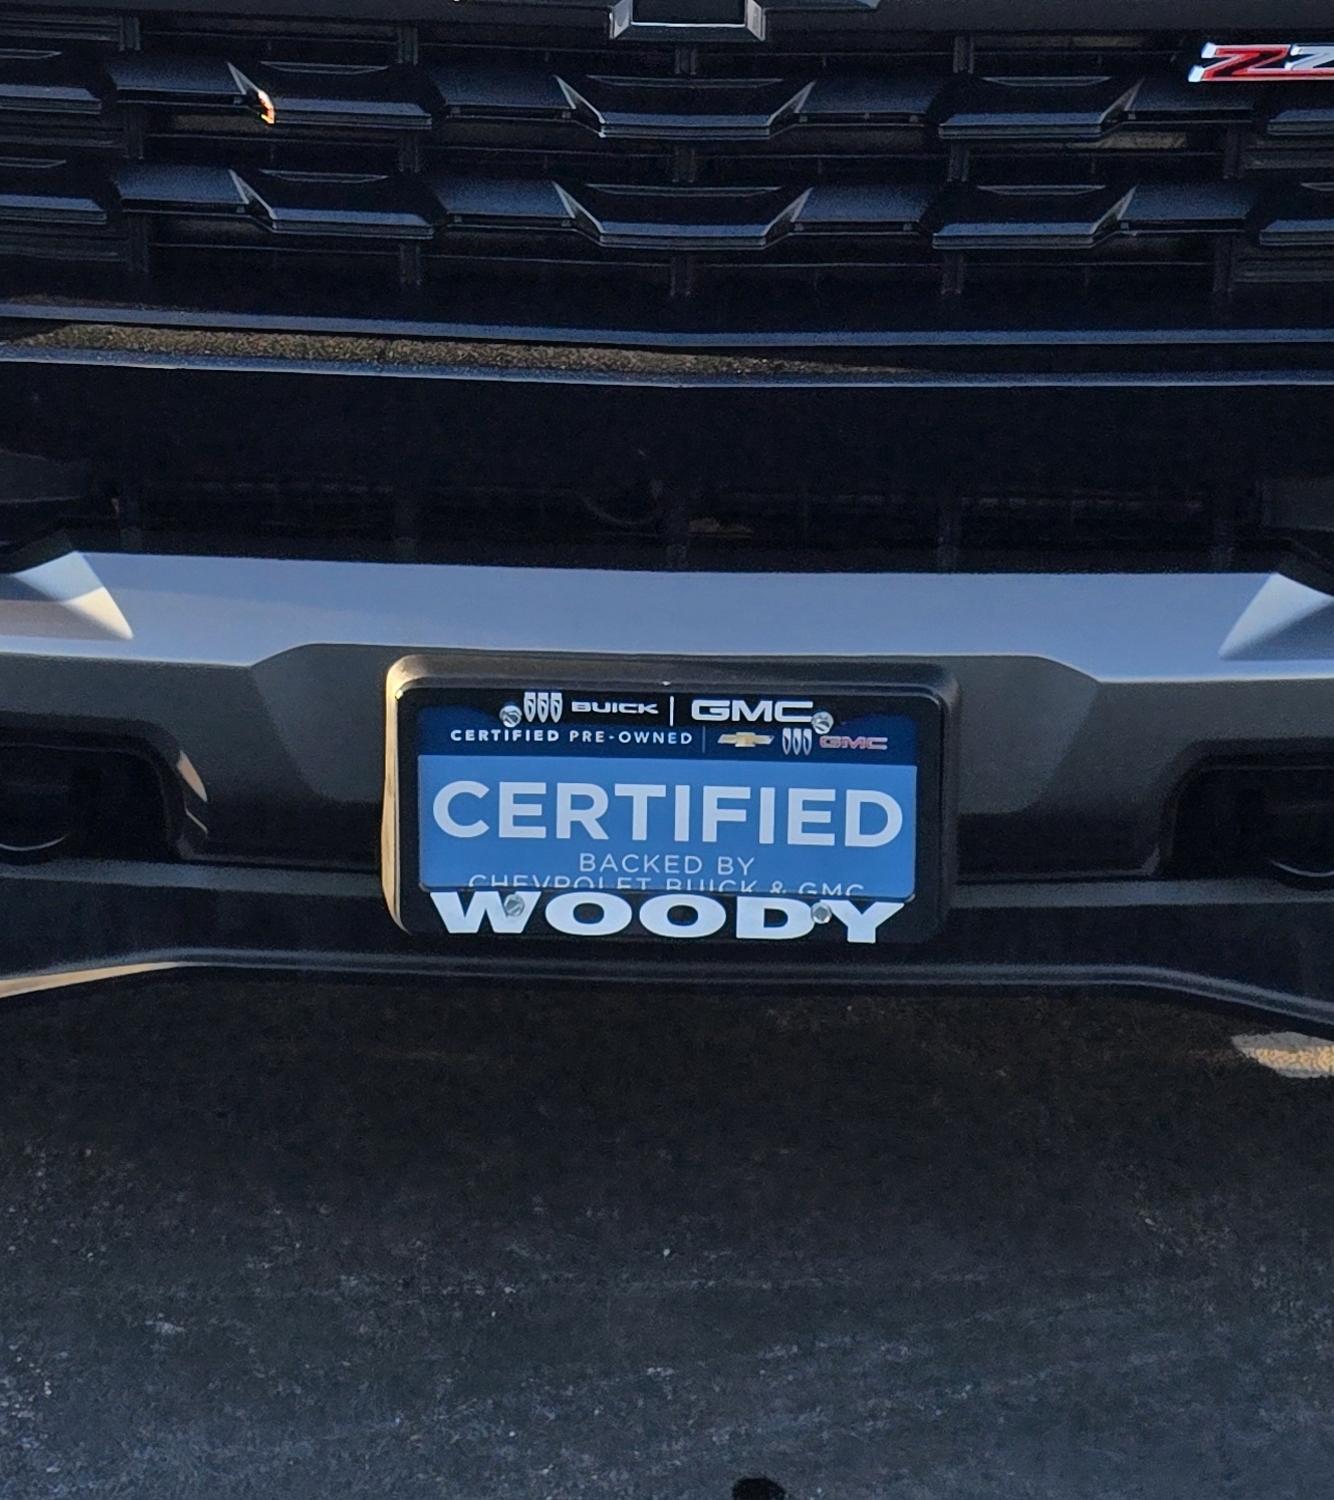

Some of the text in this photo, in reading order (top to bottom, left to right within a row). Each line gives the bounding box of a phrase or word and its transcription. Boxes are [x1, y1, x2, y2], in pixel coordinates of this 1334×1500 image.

[571, 699, 814, 723] BUICK GMC
[450, 729, 693, 745] CERTIFIED PRE-OWNED
[819, 735, 889, 750] GMC
[433, 781, 903, 847] CERTIFIED
[580, 853, 755, 876] BACKED BY
[430, 891, 905, 944] WOODY
